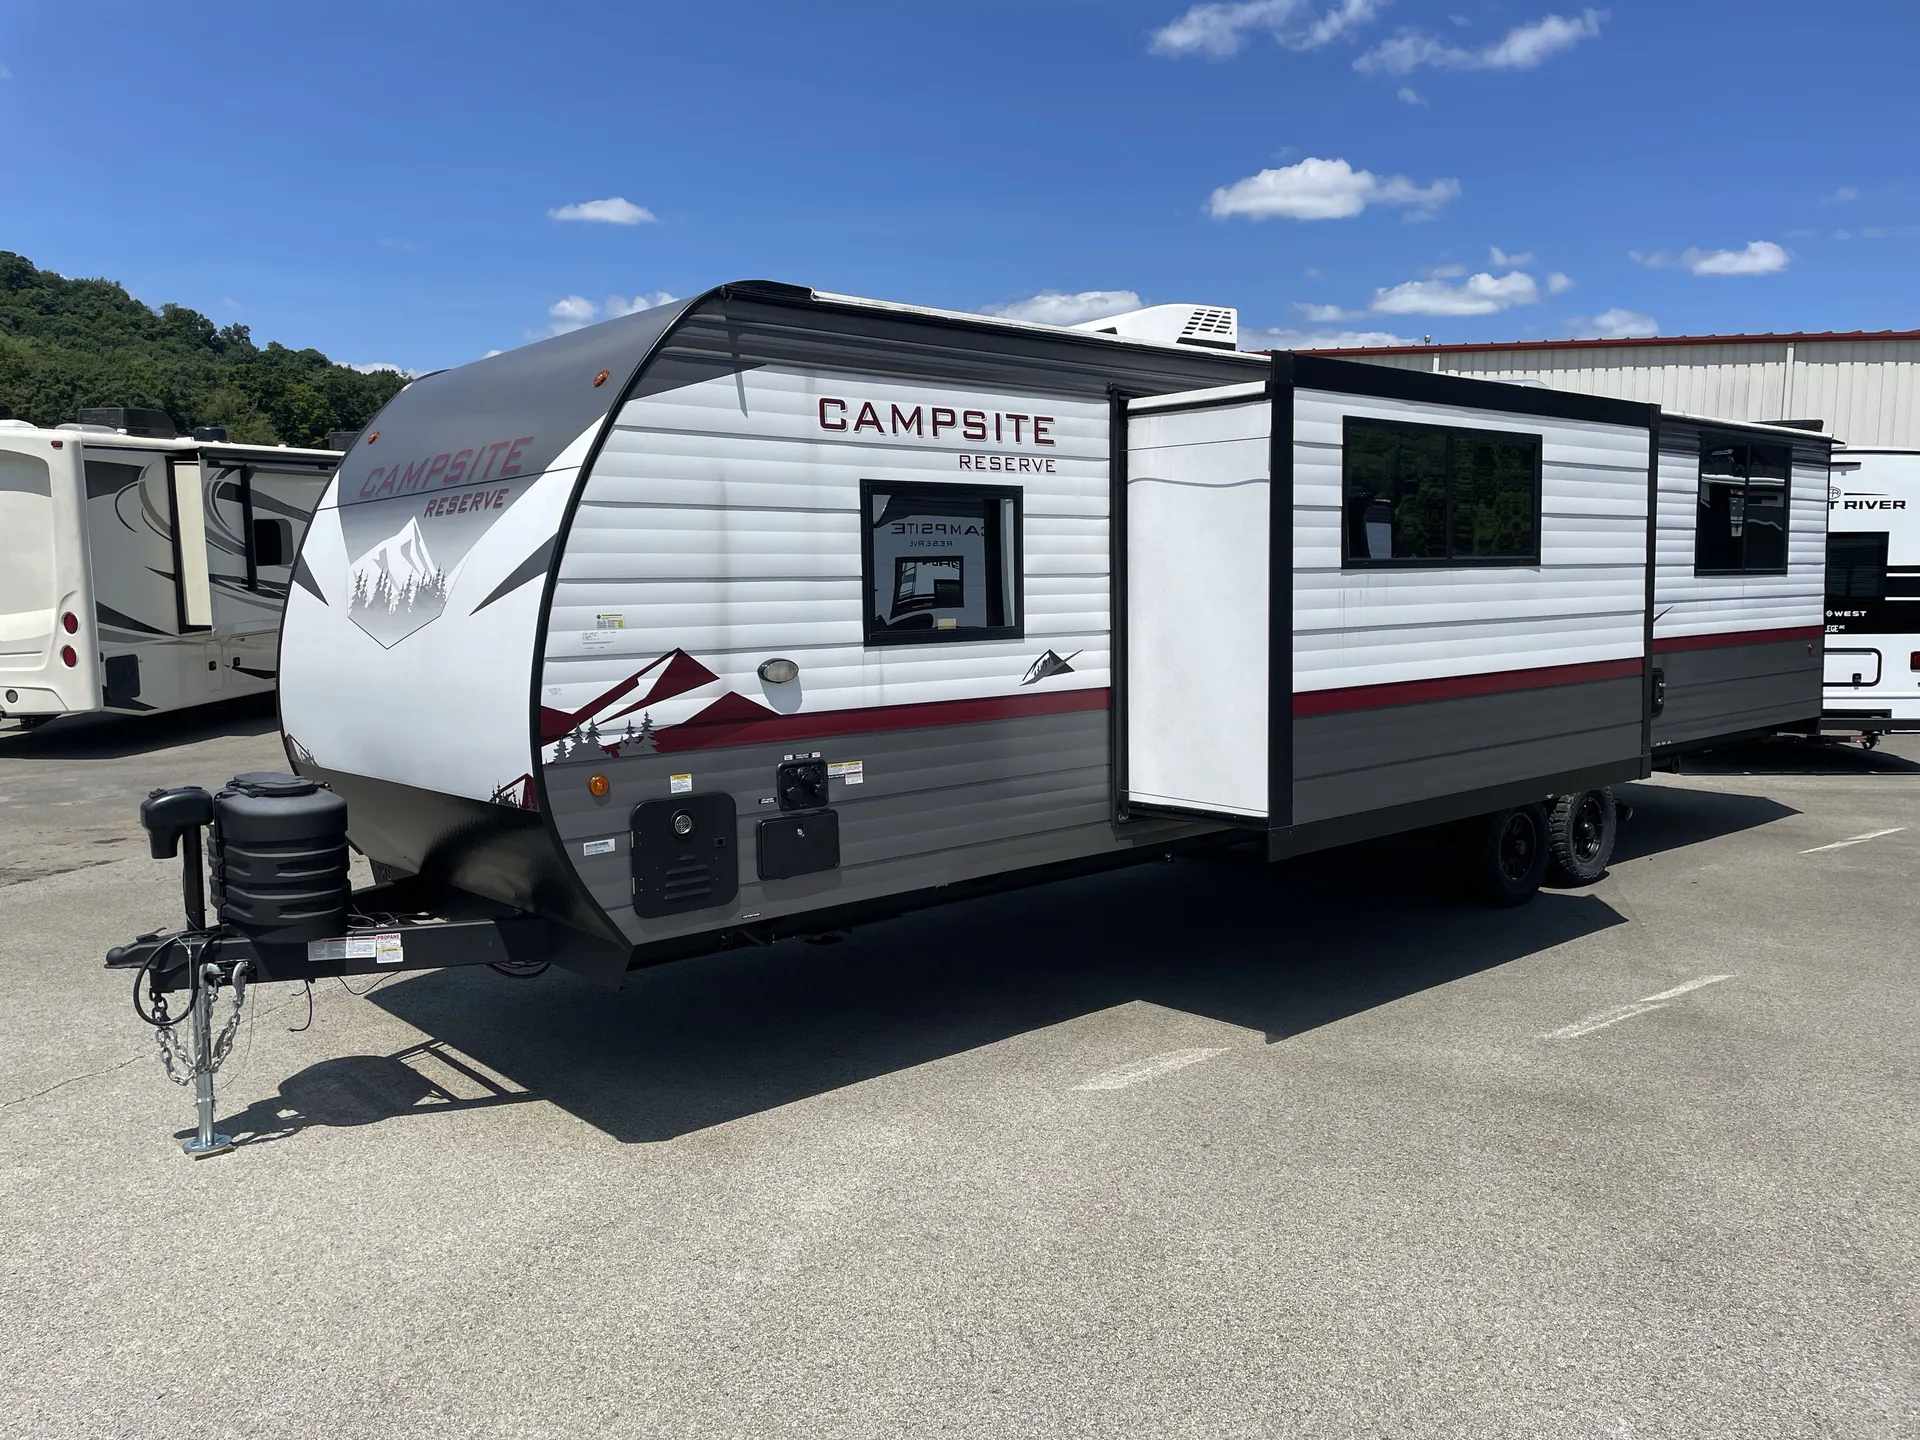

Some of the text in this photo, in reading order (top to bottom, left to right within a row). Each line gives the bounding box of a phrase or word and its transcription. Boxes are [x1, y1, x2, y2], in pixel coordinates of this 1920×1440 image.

[819, 397, 1055, 445] CAMPSITE
[359, 436, 534, 498] CAMPSITE
[959, 454, 1056, 473] RESERVE
[423, 488, 510, 518] RESERVE
[1844, 501, 1906, 509] RIVER
